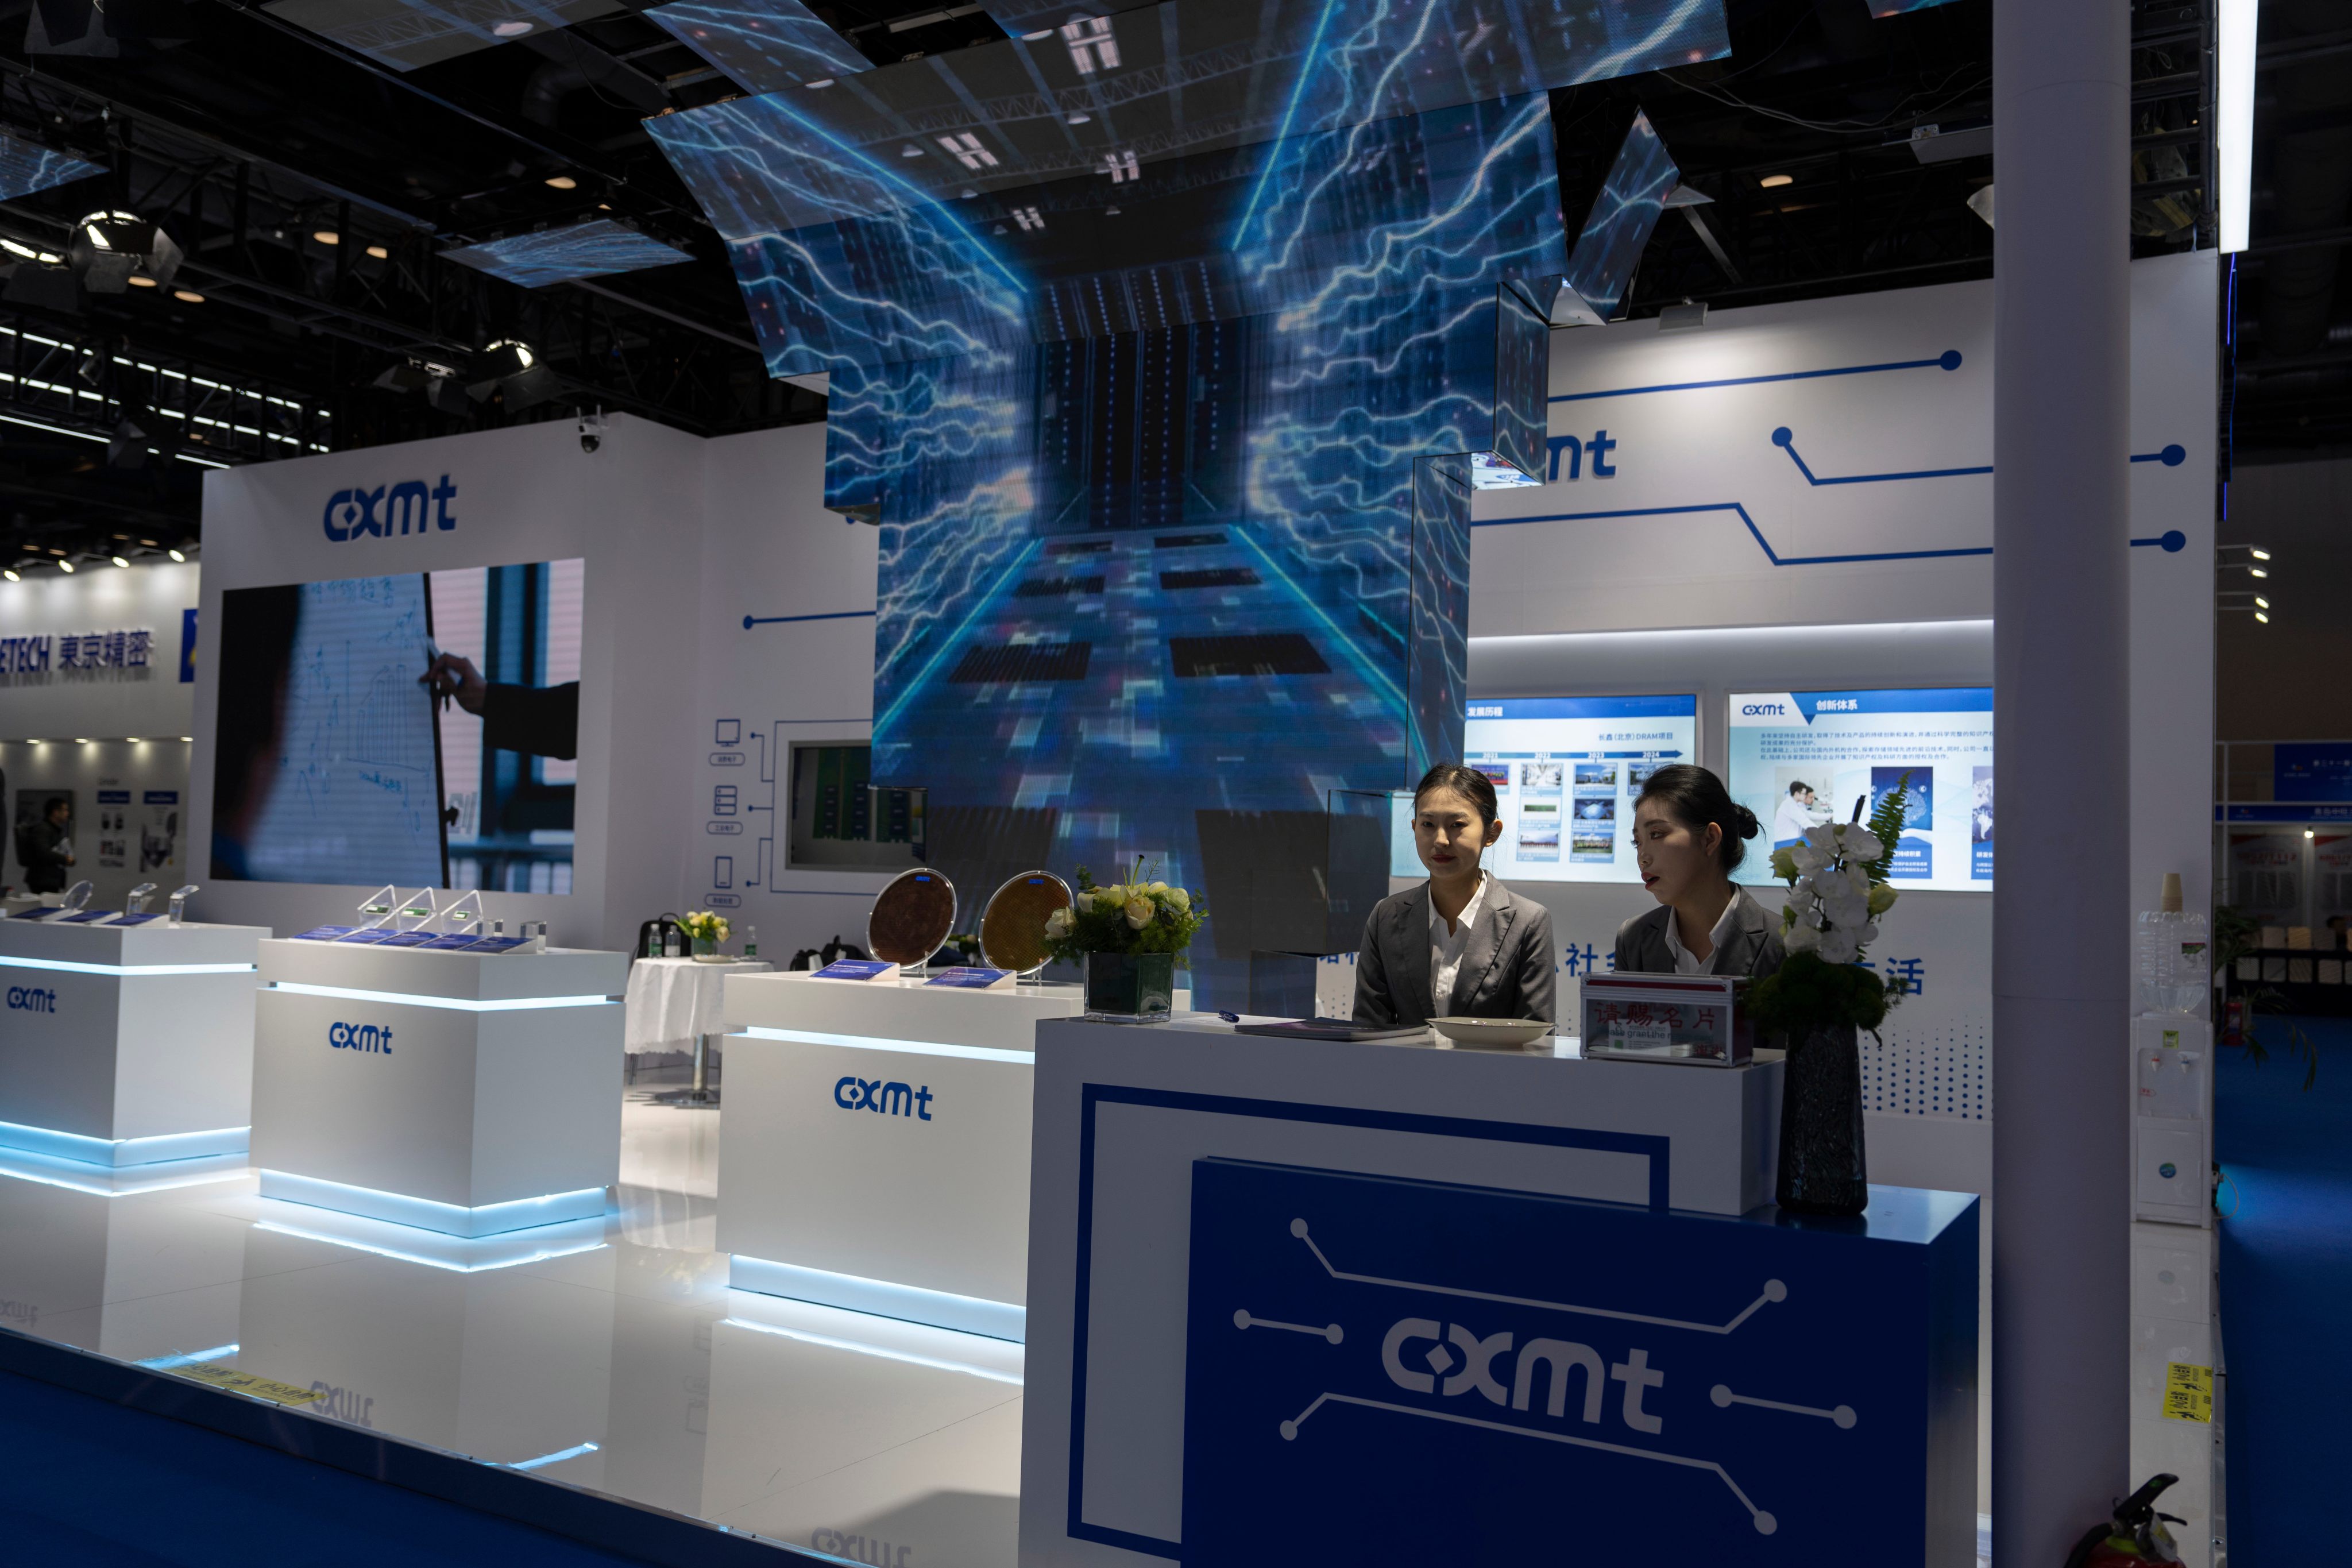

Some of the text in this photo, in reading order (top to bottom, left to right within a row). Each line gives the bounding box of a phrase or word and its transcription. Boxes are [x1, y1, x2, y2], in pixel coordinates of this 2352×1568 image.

[59, 628, 153, 670] 東京精密
[1816, 699, 1858, 711] 创新体系
[1467, 706, 1503, 717] 发展历程
